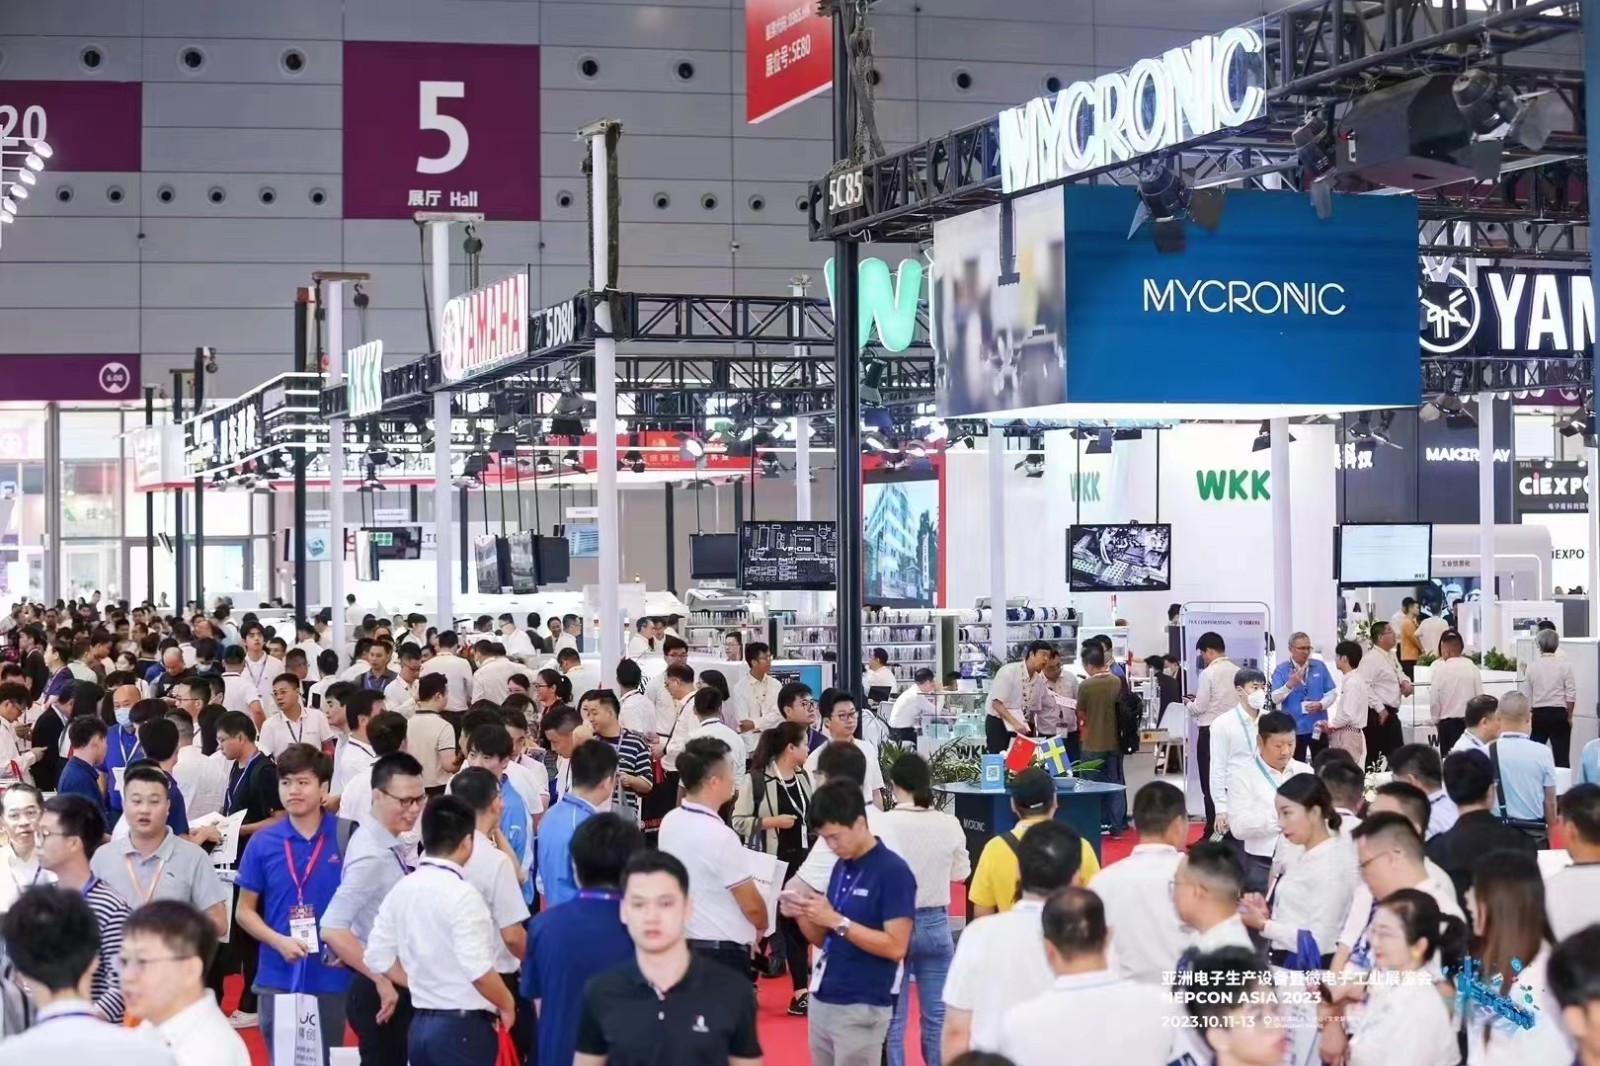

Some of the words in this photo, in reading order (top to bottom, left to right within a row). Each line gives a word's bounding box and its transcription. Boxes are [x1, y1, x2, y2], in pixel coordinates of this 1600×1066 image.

[416, 80, 470, 174] 5
[999, 27, 1264, 194] MYCRONIC
[408, 189, 441, 206] 展厅
[450, 190, 478, 207] Hall
[828, 171, 862, 210] 5C85
[1143, 278, 1346, 316] MYCRONIC
[457, 273, 529, 375] YAMAHA
[545, 300, 575, 349] 5D80
[1425, 447, 1511, 462] MAKERAY
[1069, 470, 1100, 502] WKK
[1196, 469, 1271, 501] WKK
